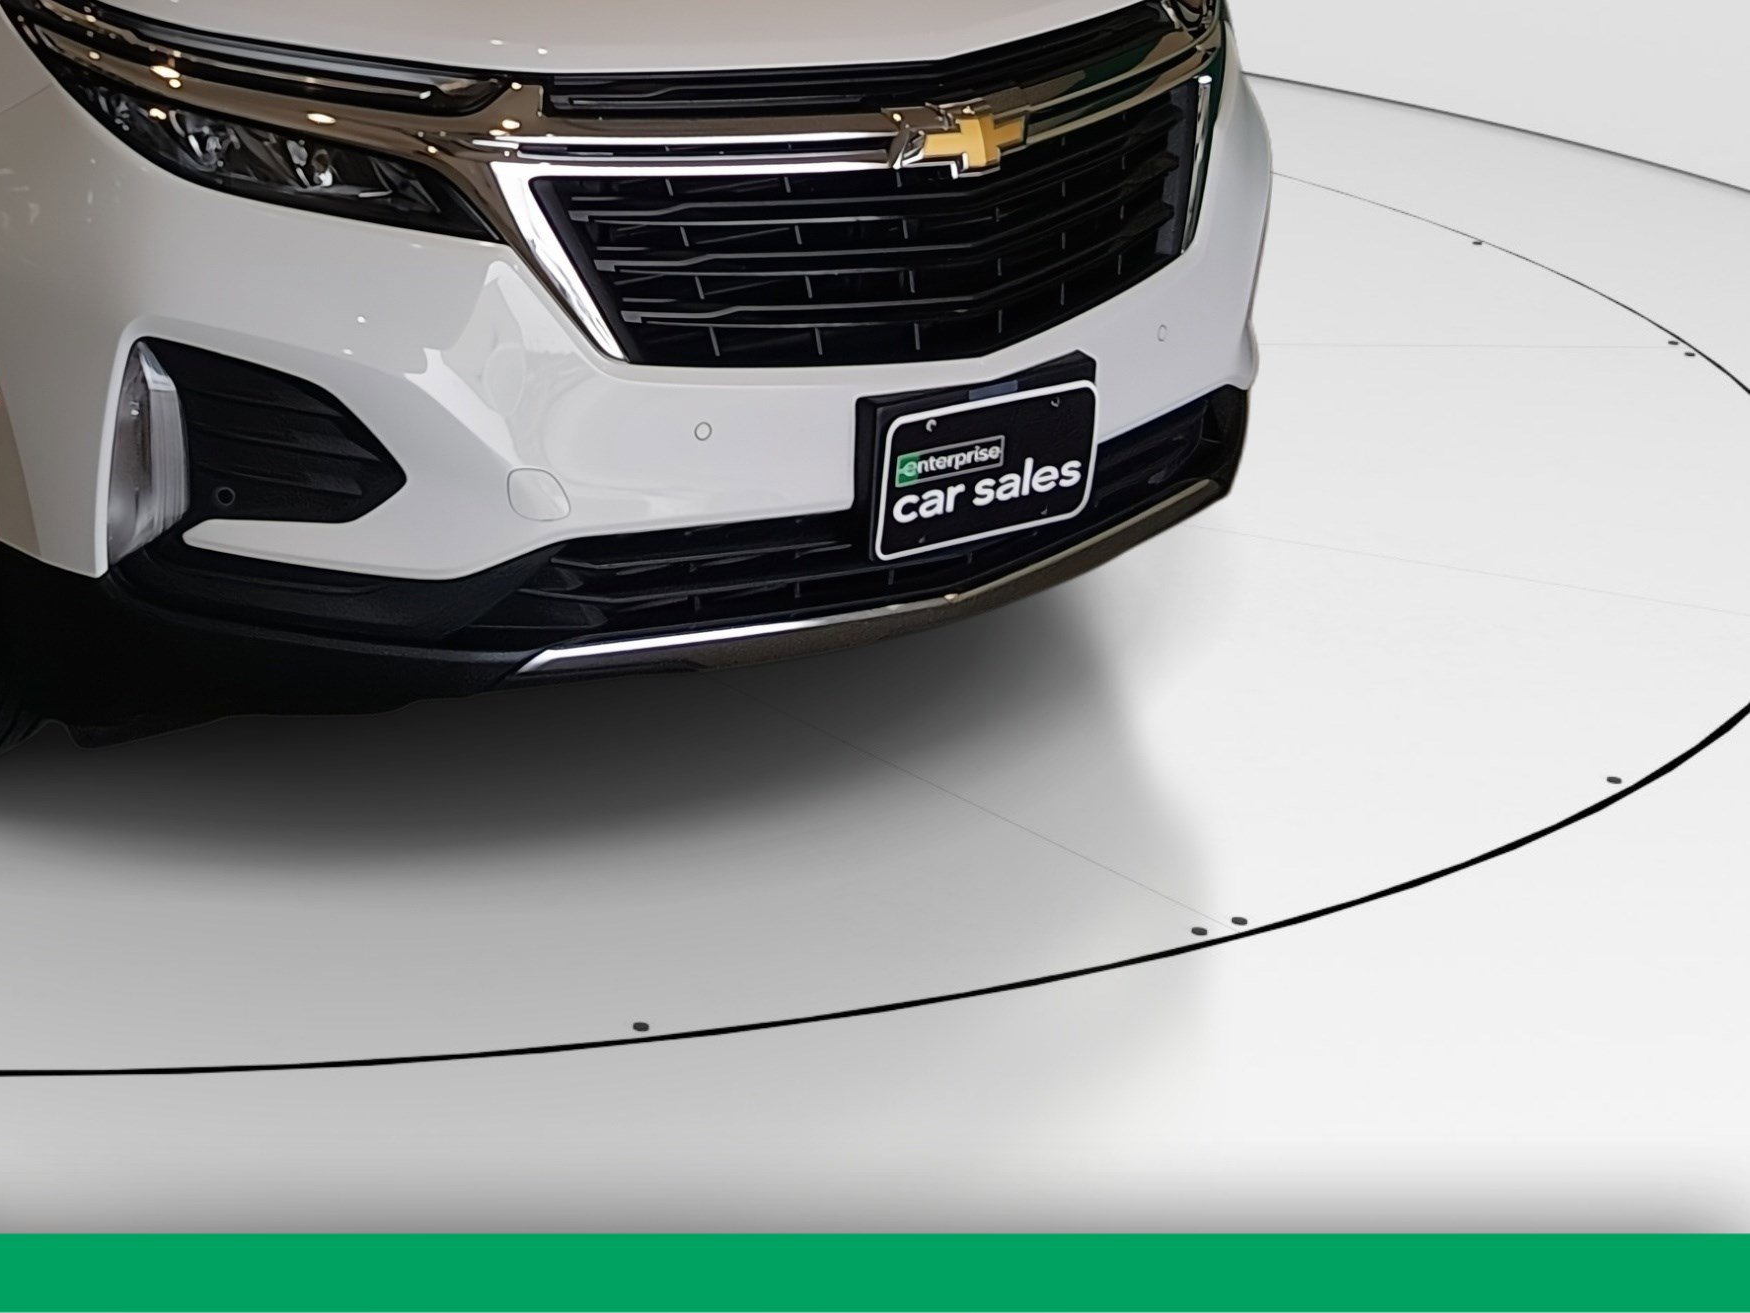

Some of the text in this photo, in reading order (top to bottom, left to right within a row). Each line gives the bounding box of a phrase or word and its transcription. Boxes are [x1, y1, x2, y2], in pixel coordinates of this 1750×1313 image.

[899, 445, 1002, 476] enterprise
[892, 457, 1082, 524] car sales
